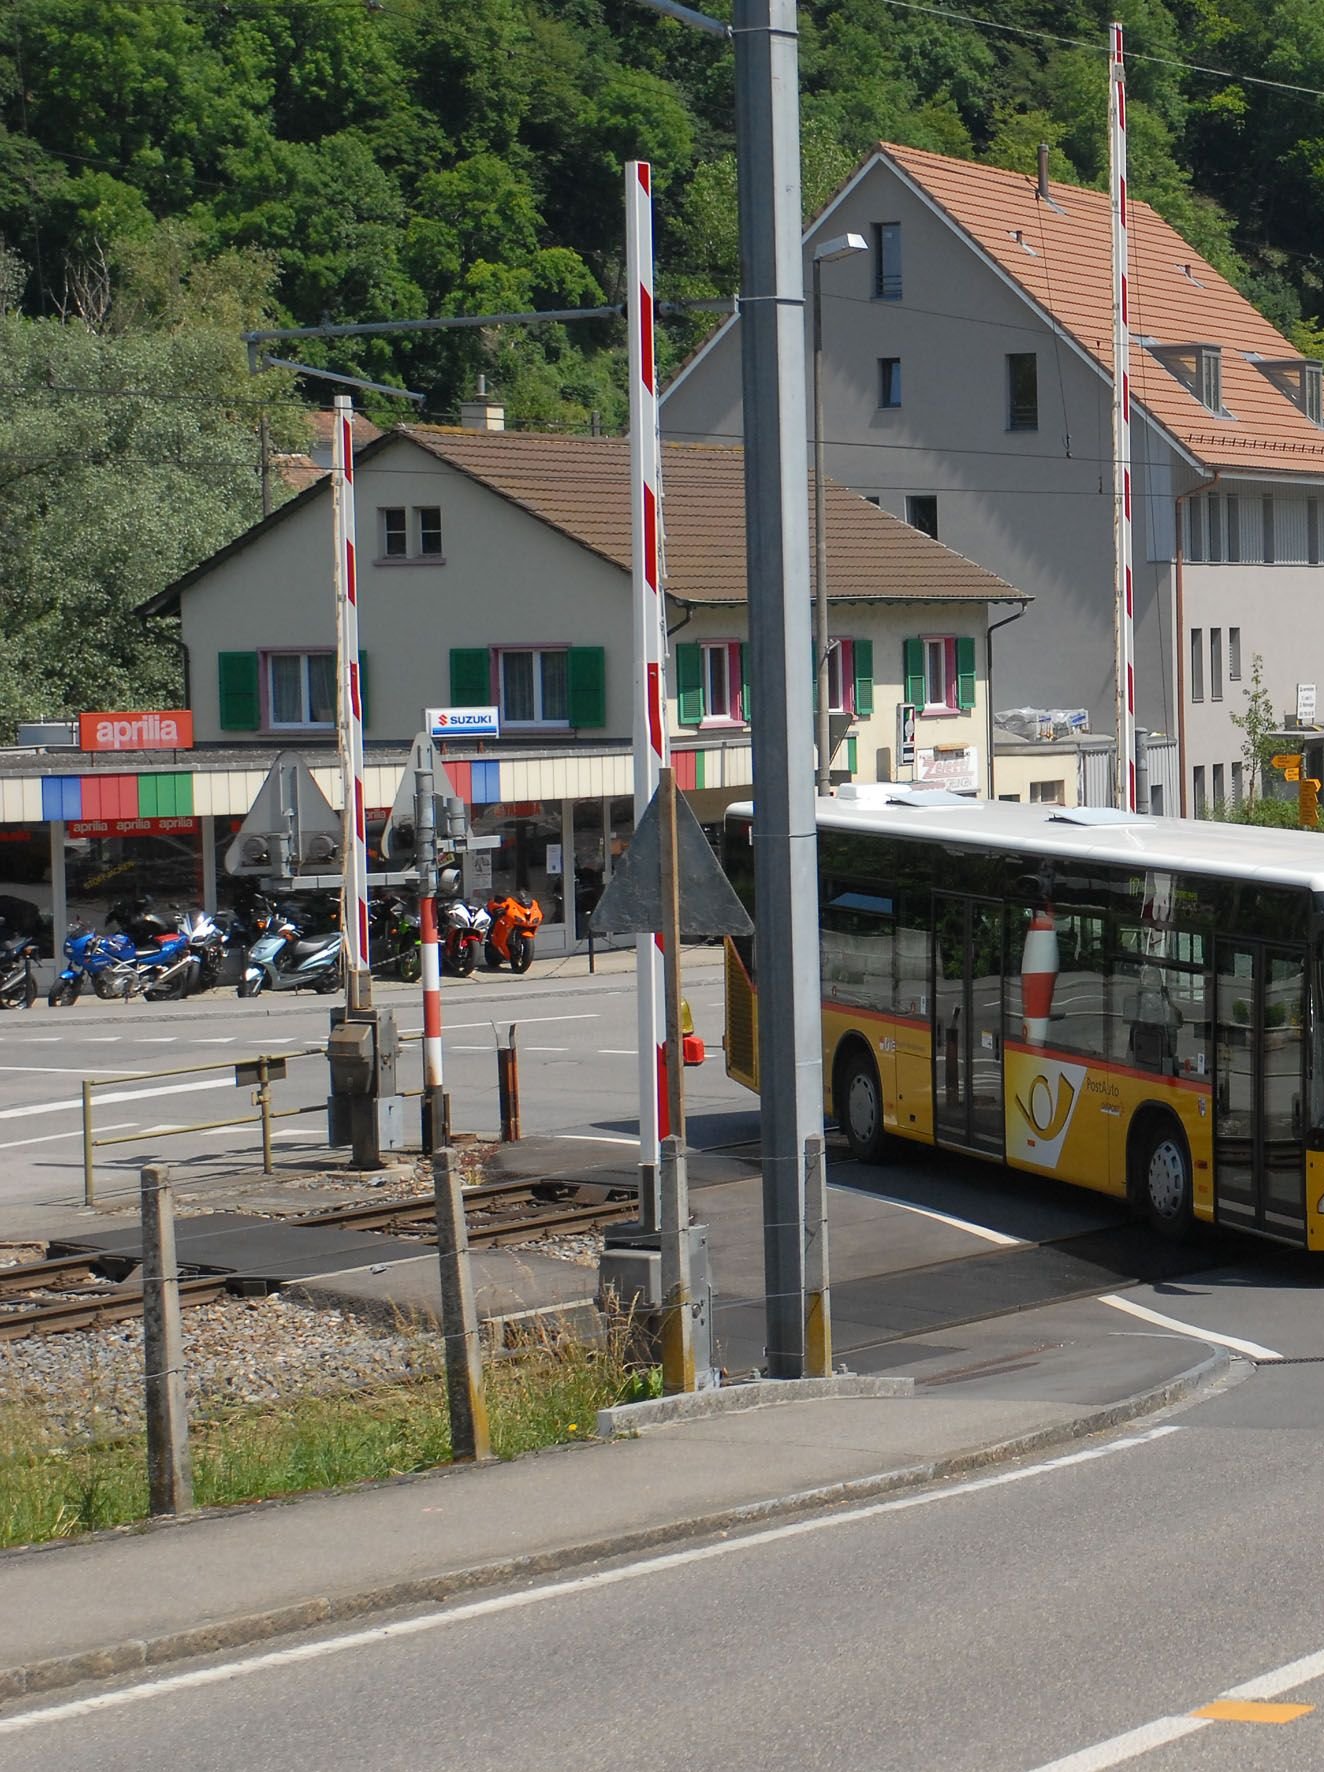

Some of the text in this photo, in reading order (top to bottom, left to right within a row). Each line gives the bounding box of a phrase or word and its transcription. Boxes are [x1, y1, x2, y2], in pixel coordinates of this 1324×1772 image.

[450, 715, 492, 725] SUZUKI
[96, 715, 177, 748] aprilia
[73, 816, 193, 833] aprilia aprilia aprilia
[1086, 1077, 1120, 1097] PostAuto
